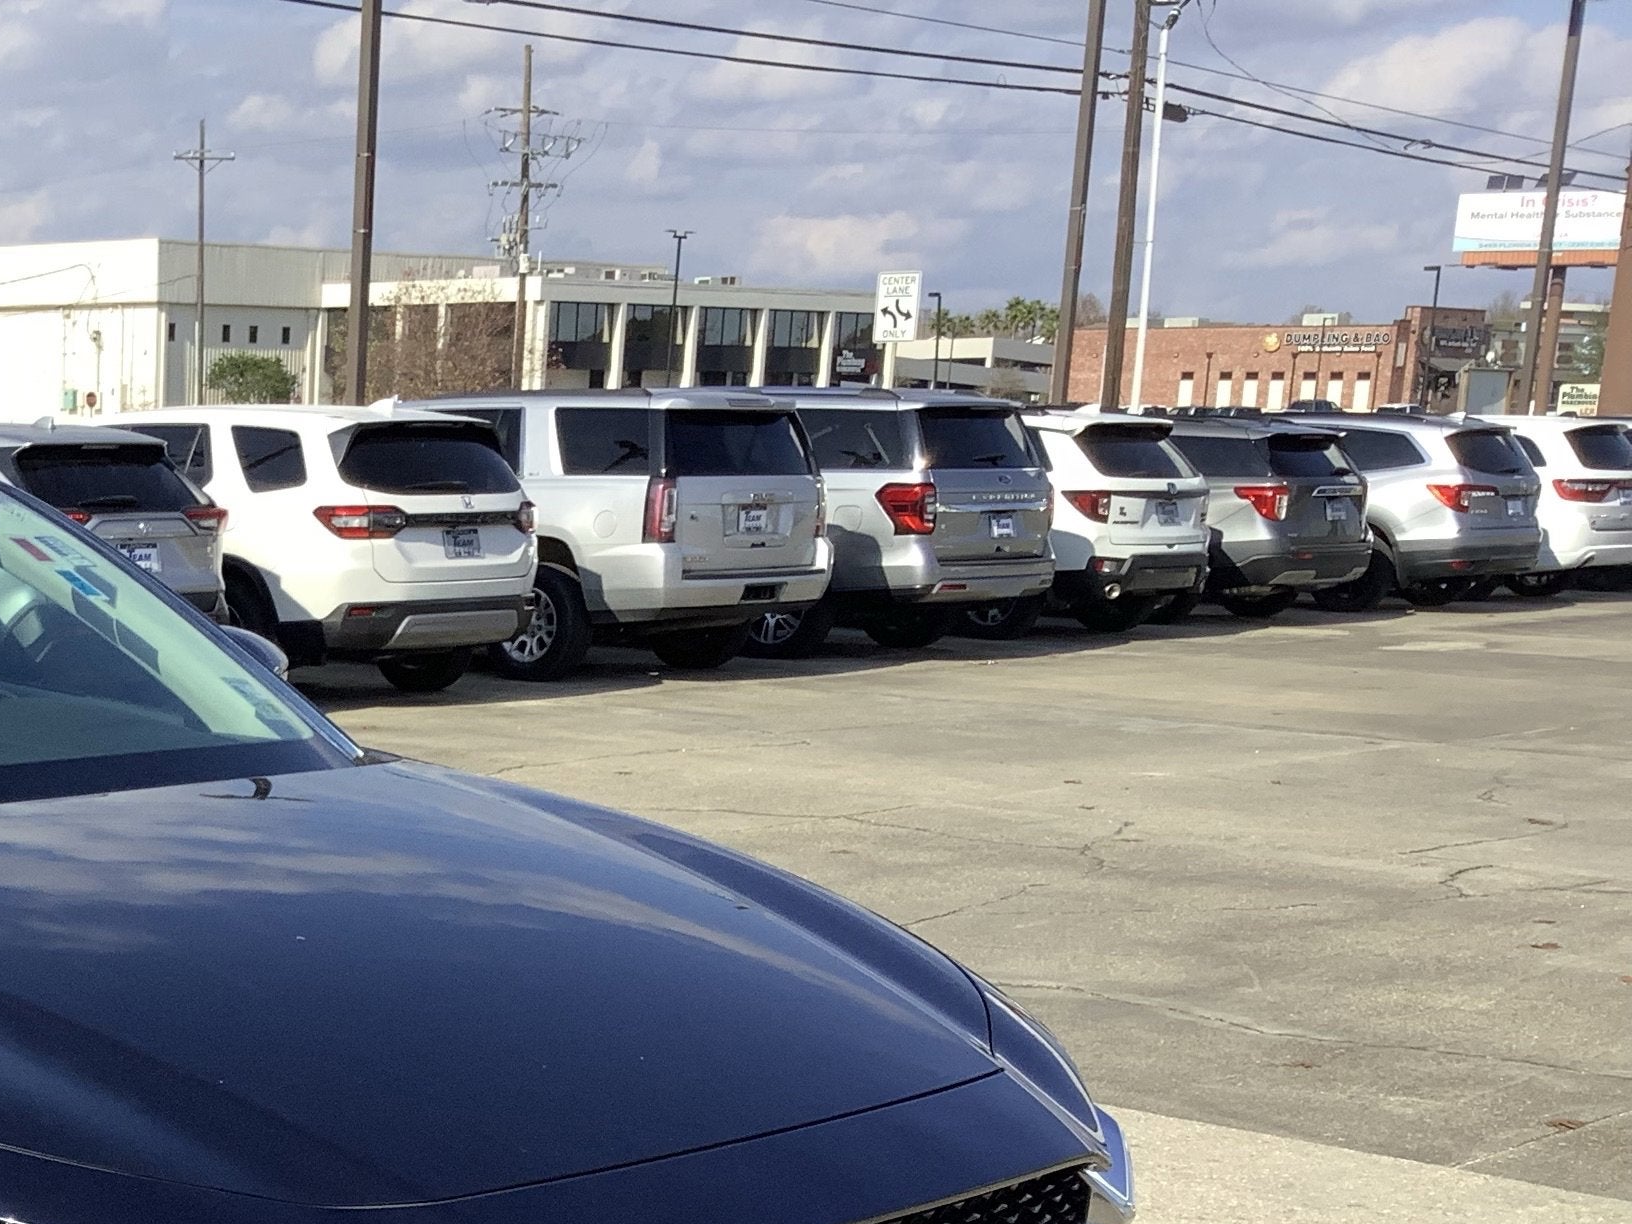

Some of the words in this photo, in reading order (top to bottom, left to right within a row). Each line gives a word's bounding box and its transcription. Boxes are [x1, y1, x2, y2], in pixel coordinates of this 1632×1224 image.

[1520, 195, 1536, 208] In
[1470, 211, 1508, 220] Mental
[1511, 209, 1544, 219] Health
[1564, 208, 1622, 219] Substance
[882, 276, 916, 285] CENTER
[887, 286, 910, 295] LANE
[882, 329, 907, 339] ONLY
[1352, 332, 1363, 343] &
[1365, 332, 1391, 344] BAO
[1562, 391, 1598, 400] Plumbin
[744, 511, 762, 522] TEAM
[127, 550, 152, 561] TEAM
